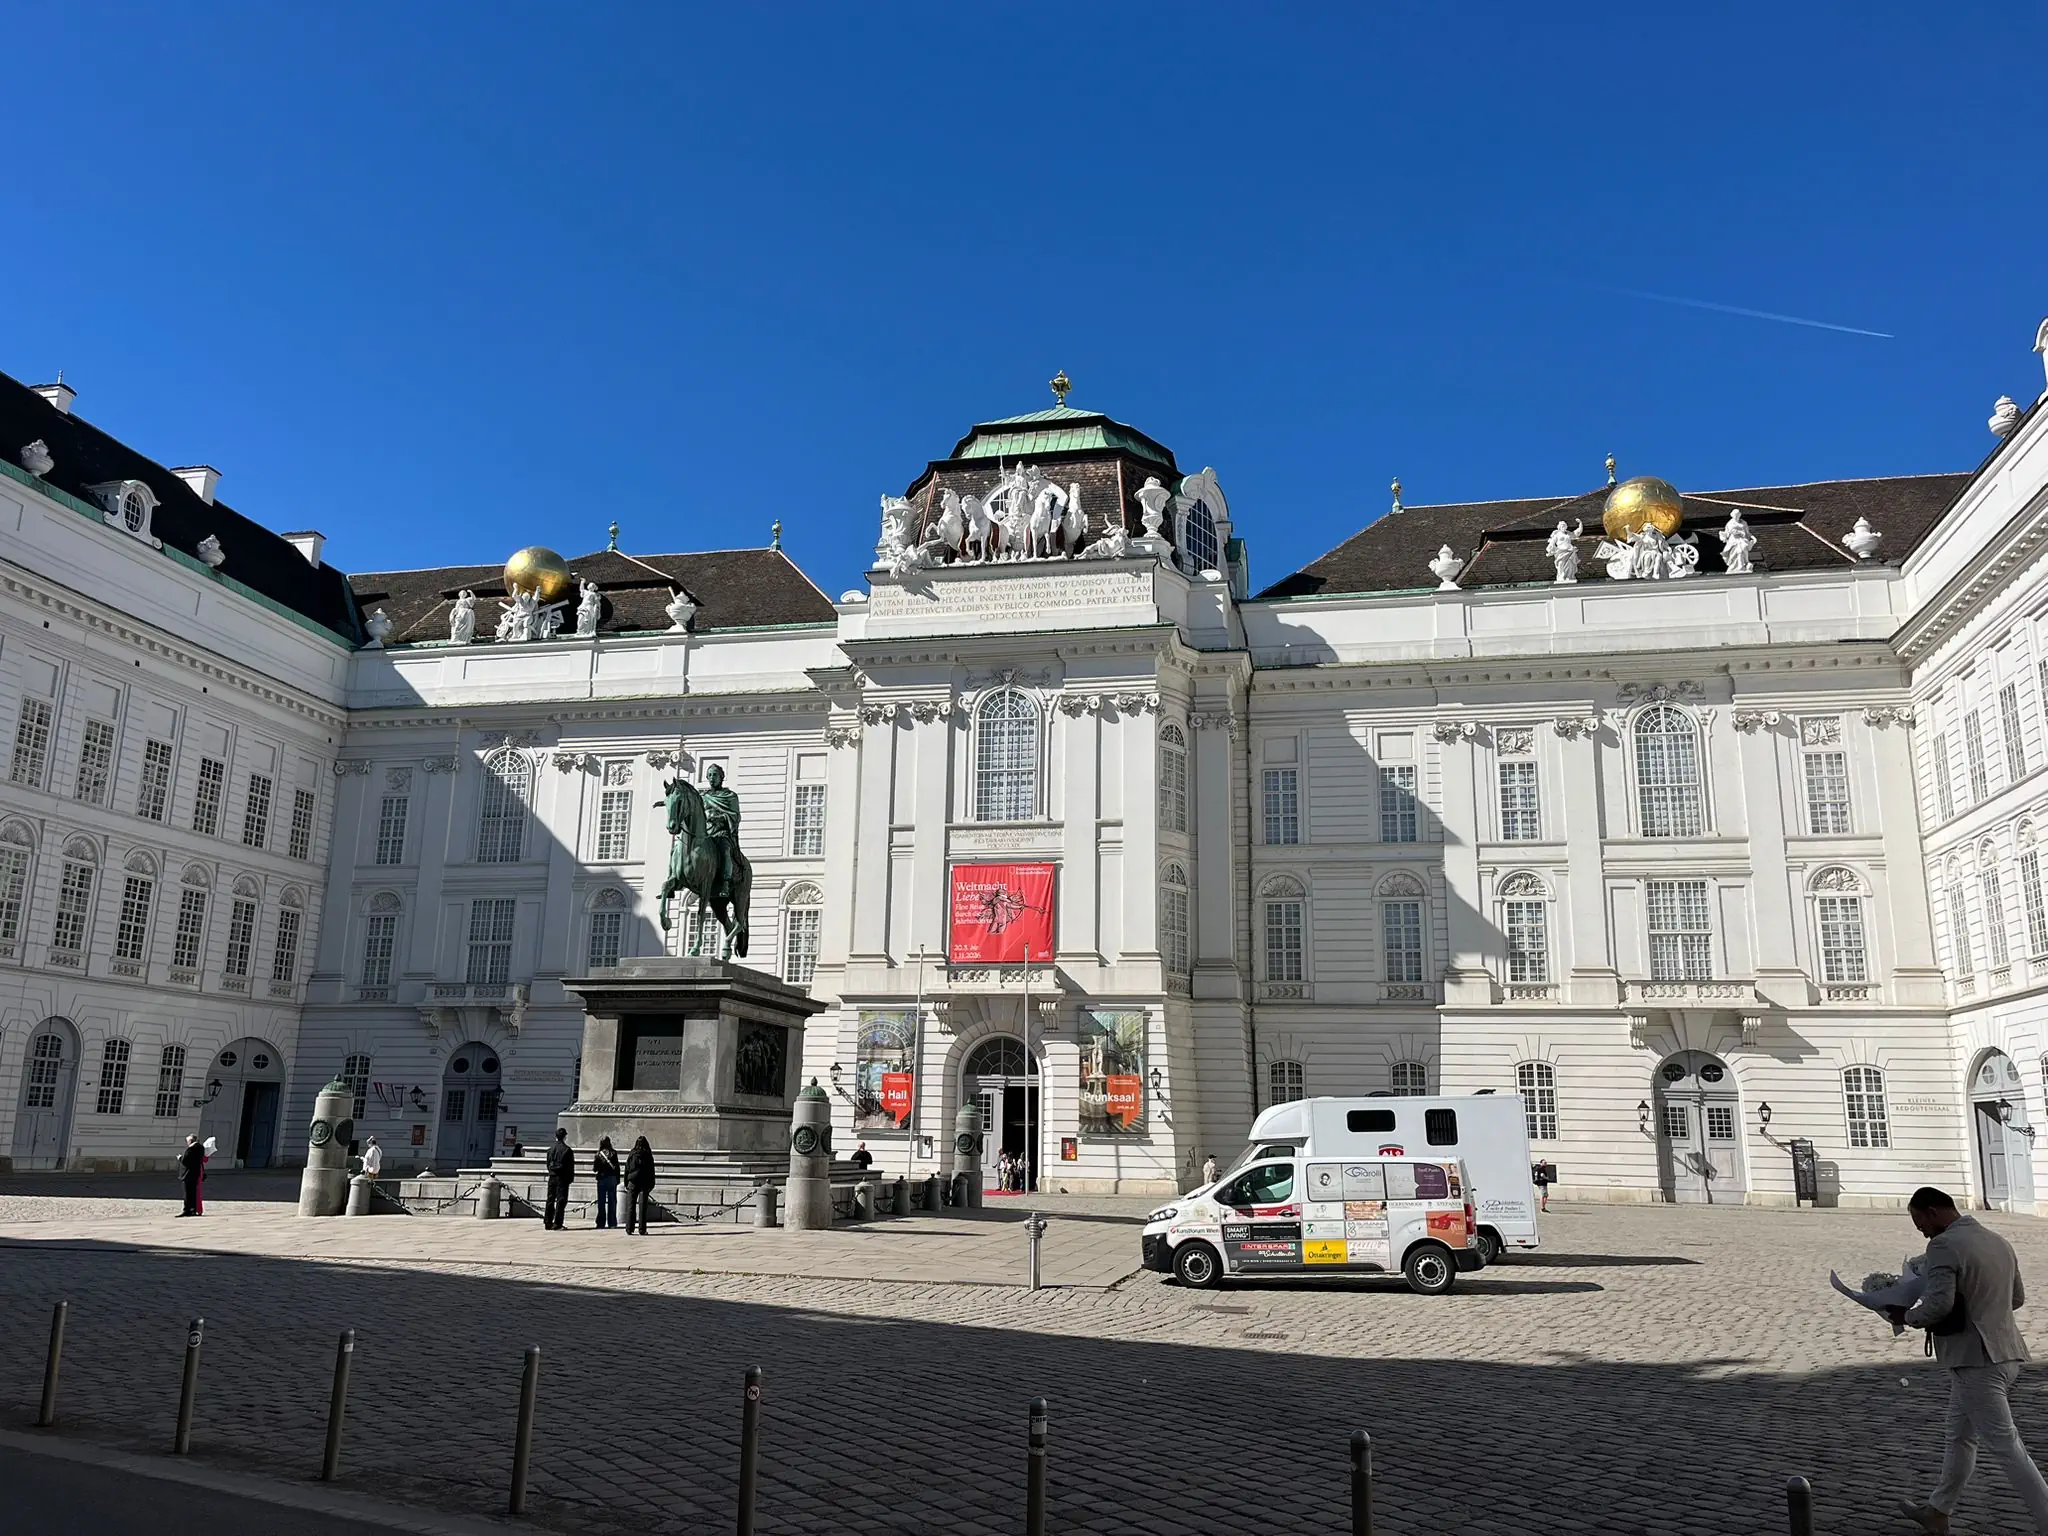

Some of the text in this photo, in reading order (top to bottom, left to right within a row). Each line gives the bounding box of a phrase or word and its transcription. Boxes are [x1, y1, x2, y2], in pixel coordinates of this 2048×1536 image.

[939, 586, 986, 595] CONFECTO
[990, 582, 1049, 592] INSTAVRANDIS
[1055, 577, 1113, 588] FOVENDISQVE
[873, 600, 904, 608] AVITAM
[979, 593, 1015, 602] INGENTI
[1019, 590, 1068, 600] LIBRORVM
[1073, 588, 1106, 597] COPIA
[1110, 585, 1150, 594] AVCTAM
[873, 594, 1150, 616] AMPLIS EXSTRVCTIS AEDIBVS PVBLICO COMMODO PATERE IVSSIT
[955, 881, 1008, 891] Weltmacht
[955, 891, 981, 901] Liebe
[858, 1089, 907, 1100] State Hall
[1083, 1092, 1135, 1102] Prunksaal
[1308, 1251, 1342, 1259] Ottakringer
